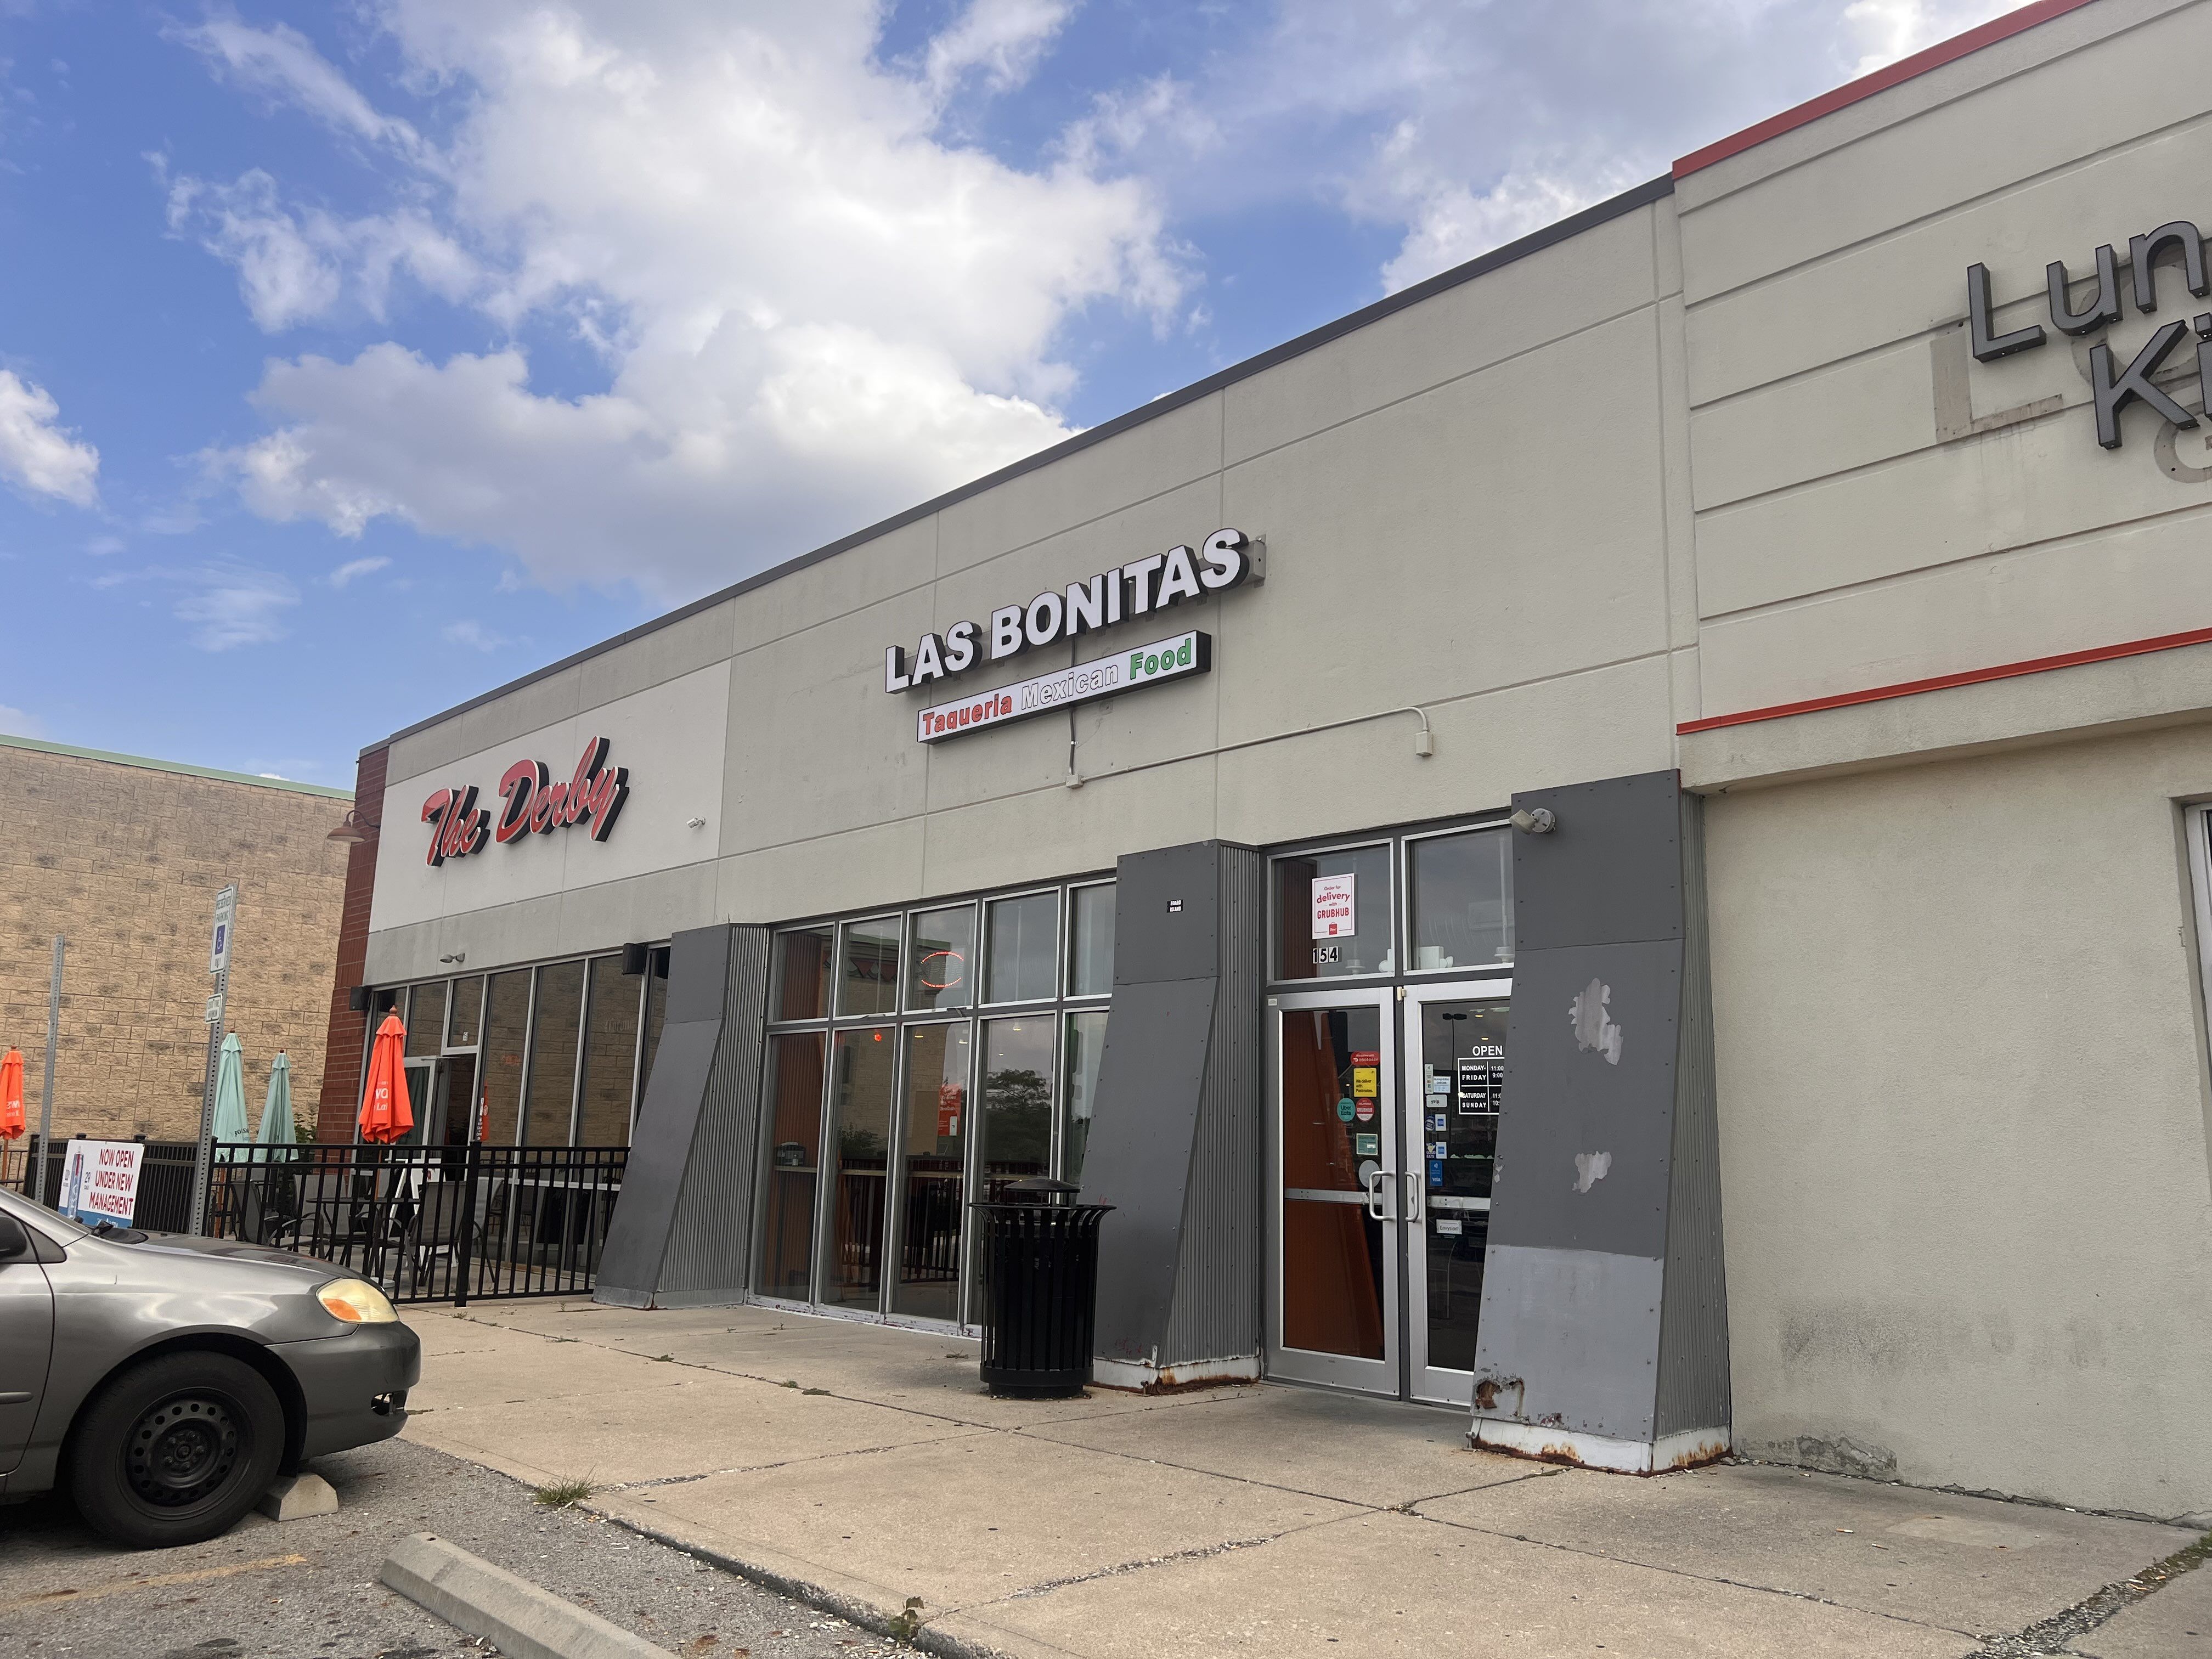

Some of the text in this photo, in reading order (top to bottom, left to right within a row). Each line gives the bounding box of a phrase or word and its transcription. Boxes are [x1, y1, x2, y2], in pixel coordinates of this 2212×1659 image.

[885, 528, 1249, 693] LAS BONITAS
[923, 637, 1192, 736] Taqueria Mexican Food
[421, 736, 630, 867] The Derby
[1317, 892, 1350, 904] delivery
[1317, 907, 1350, 919] GRUBHUB
[1313, 947, 1338, 962] 154
[1472, 1045, 1503, 1056] OPEN
[99, 1149, 134, 1169] NOW OPEN
[95, 1170, 133, 1192] UNDER NEW
[89, 1192, 134, 1216] MANAGEMENT
